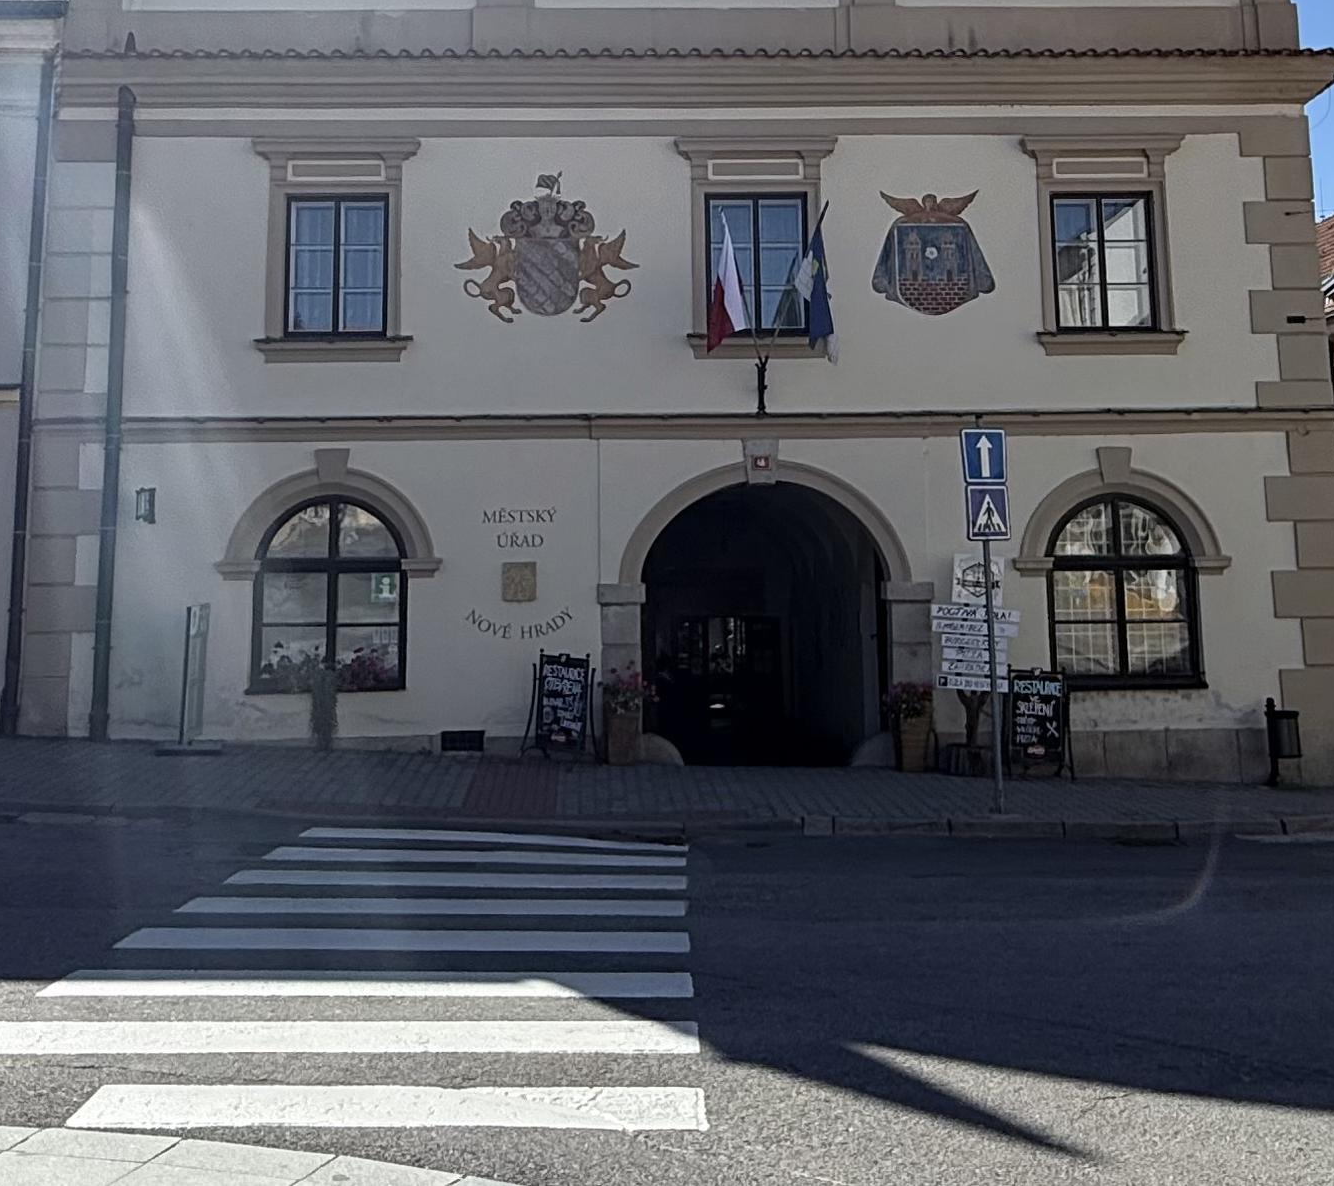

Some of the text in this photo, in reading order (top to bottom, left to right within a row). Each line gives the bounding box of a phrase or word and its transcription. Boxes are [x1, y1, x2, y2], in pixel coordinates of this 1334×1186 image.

[482, 506, 557, 524] MĚSTSKÝ
[496, 532, 544, 548] ÚŘAD
[465, 606, 574, 639] NOVÉ HRADY
